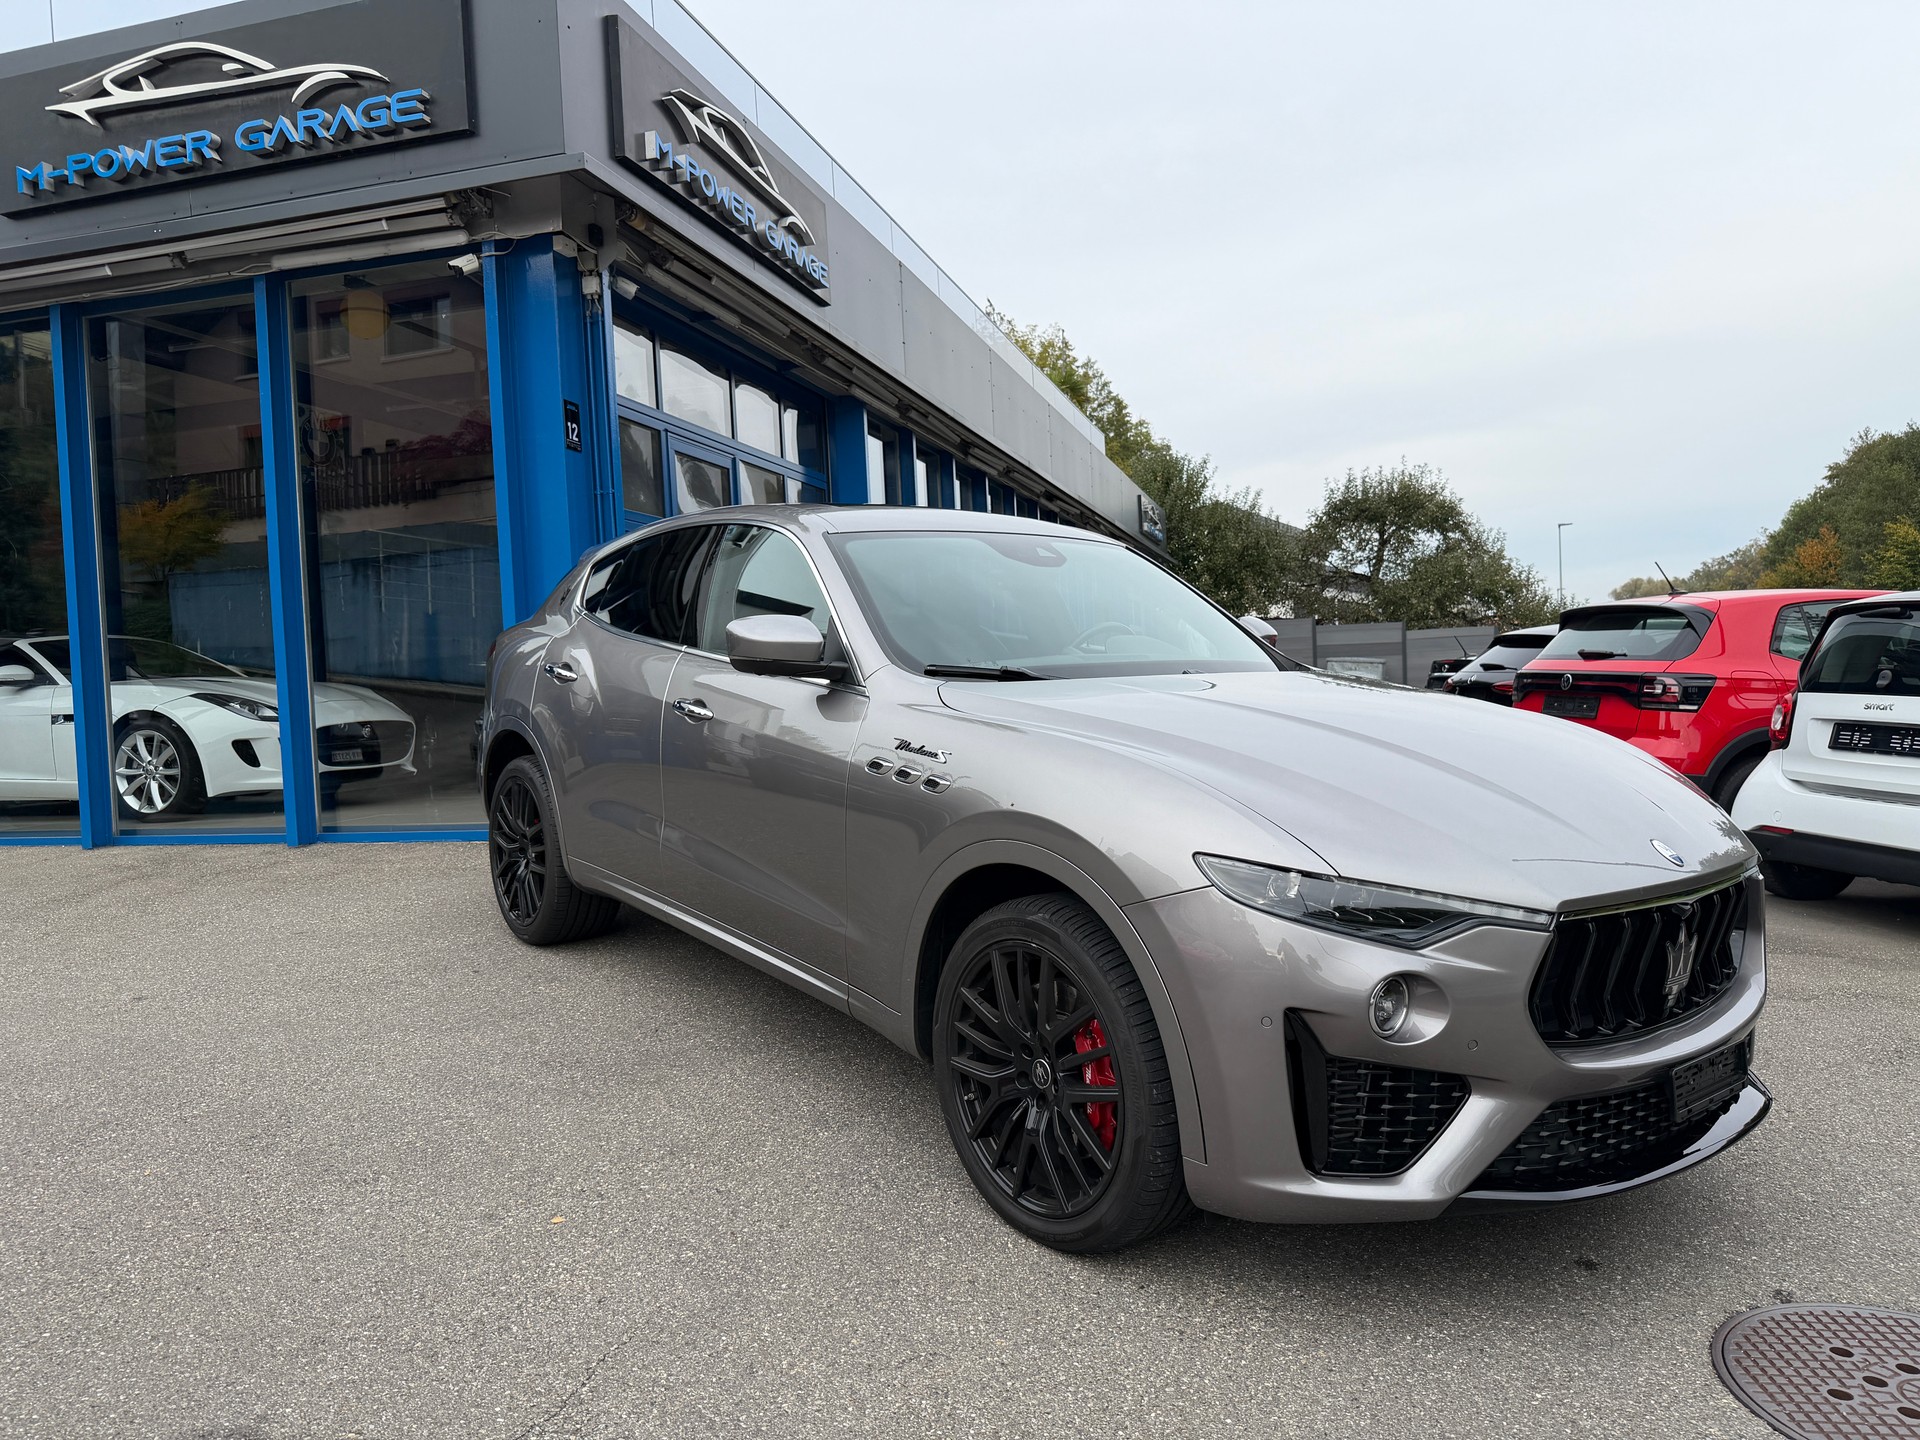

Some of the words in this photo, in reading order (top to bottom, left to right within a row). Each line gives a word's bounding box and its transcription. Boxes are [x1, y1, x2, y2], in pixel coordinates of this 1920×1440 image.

[16, 129, 217, 194] M-POWER
[235, 88, 429, 152] GARAGE
[654, 130, 758, 231] M-POWER
[765, 220, 830, 288] GARAGE
[567, 421, 579, 441] 12
[1863, 702, 1894, 711] smart
[893, 737, 938, 759] Modena
